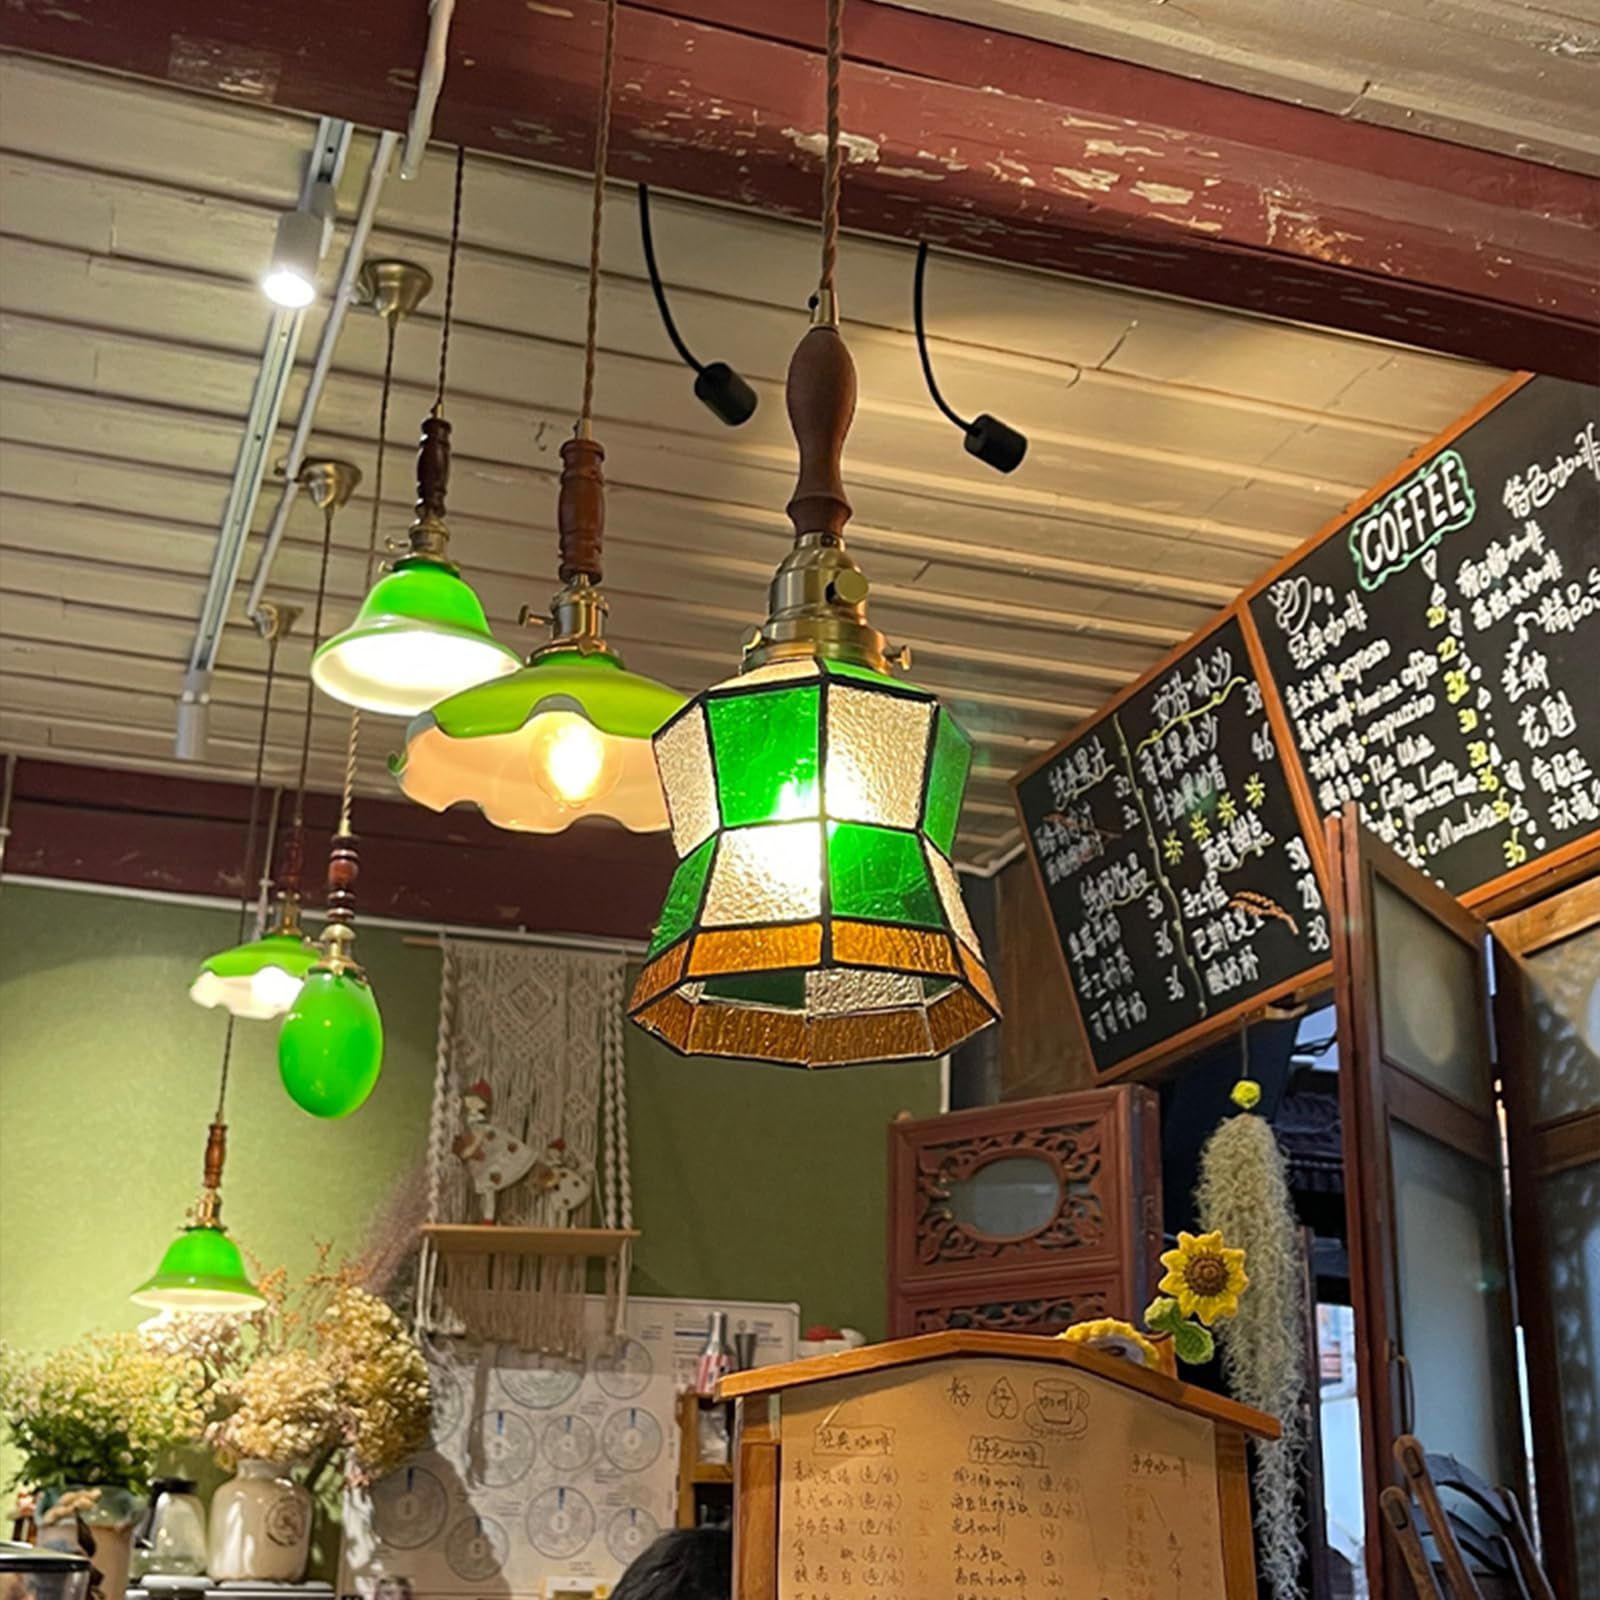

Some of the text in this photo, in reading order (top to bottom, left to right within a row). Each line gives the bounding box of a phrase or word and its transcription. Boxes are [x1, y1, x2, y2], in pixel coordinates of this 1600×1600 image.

[1359, 459, 1467, 572] COFFEE
[1439, 640, 1458, 657] 22
[1251, 721, 1275, 762] 46
[1306, 914, 1331, 952] 38
